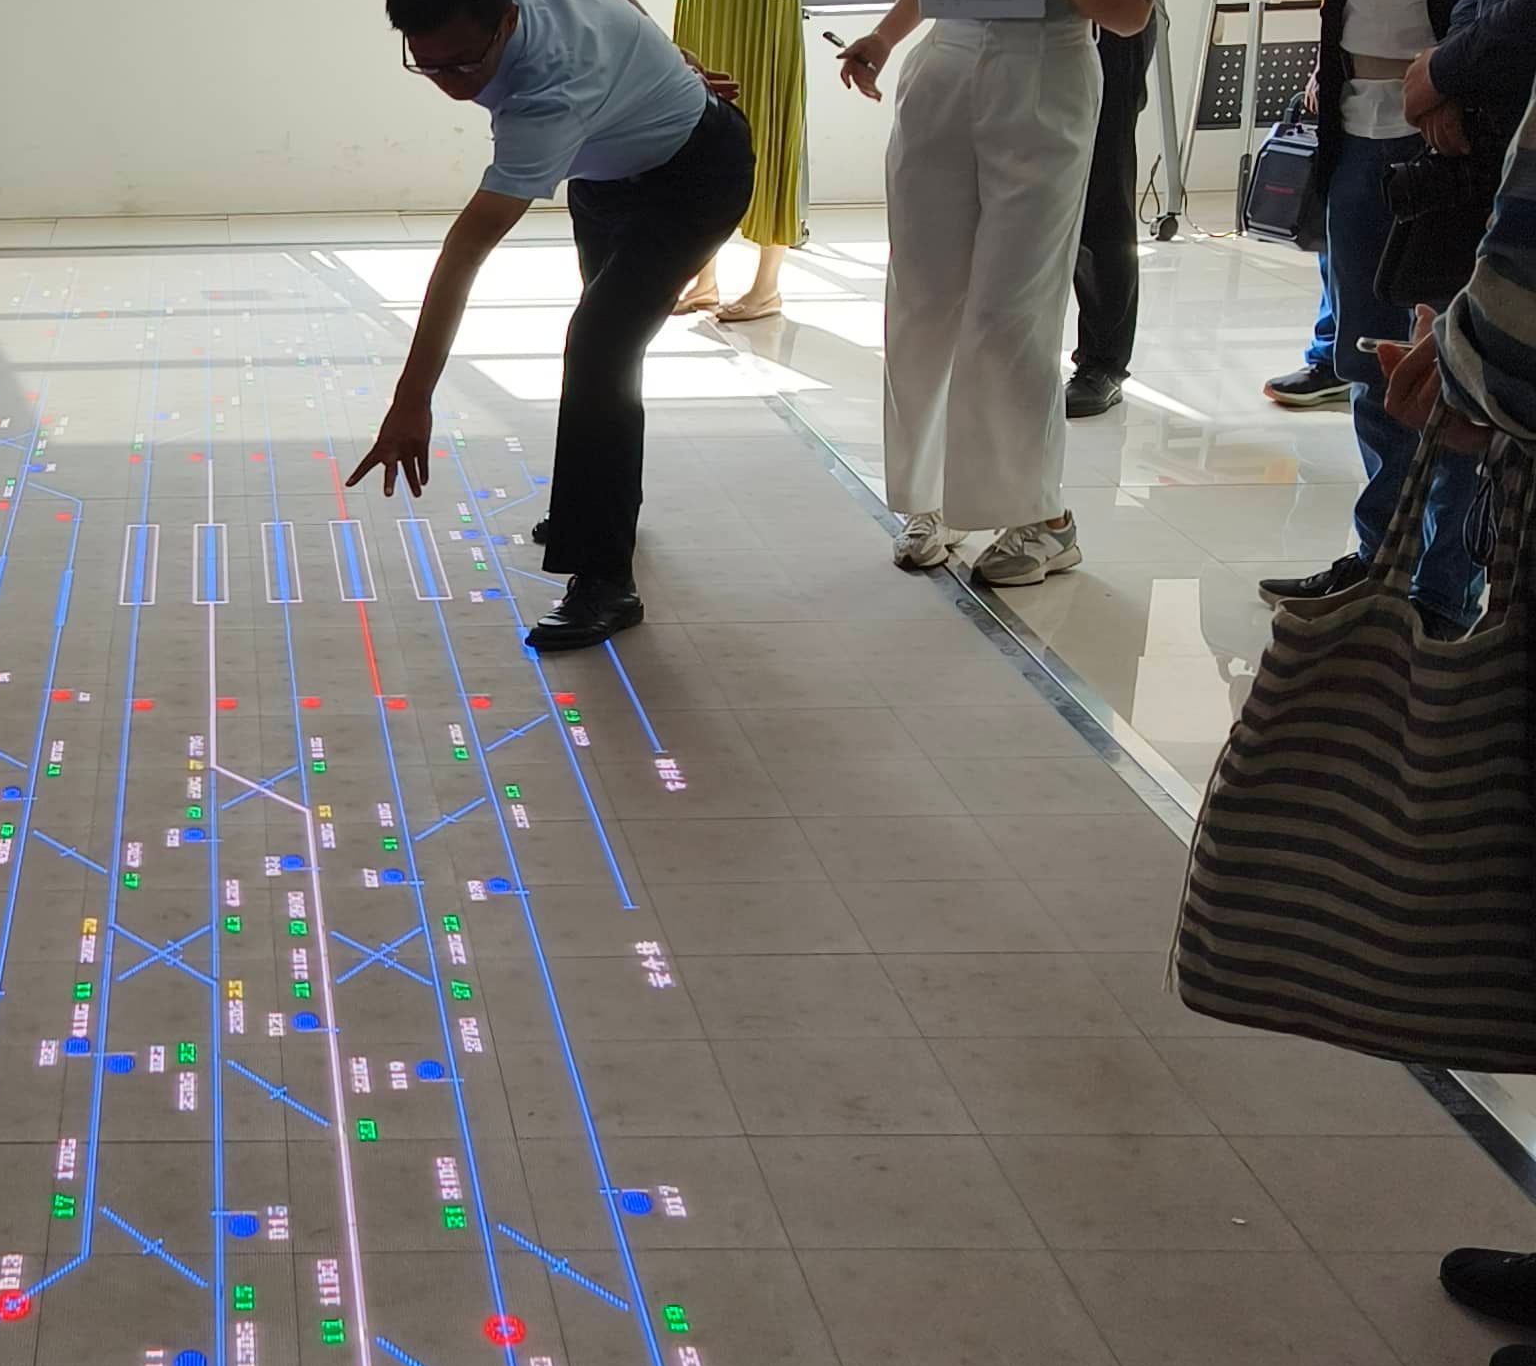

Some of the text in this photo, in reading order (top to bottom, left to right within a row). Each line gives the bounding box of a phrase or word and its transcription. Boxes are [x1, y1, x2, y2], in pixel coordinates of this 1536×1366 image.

[269, 1013, 284, 1036] D21
[389, 1061, 408, 1089] D19
[58, 1139, 76, 1179] 17DG
[52, 1194, 75, 1219] 17
[659, 1186, 686, 1217] D17
[268, 1206, 289, 1240] D15
[0, 1255, 23, 1289] D13
[317, 1259, 340, 1305] 11DG
[233, 1286, 254, 1310] 15
[321, 1320, 344, 1344] 11
[662, 1306, 688, 1333] 19
